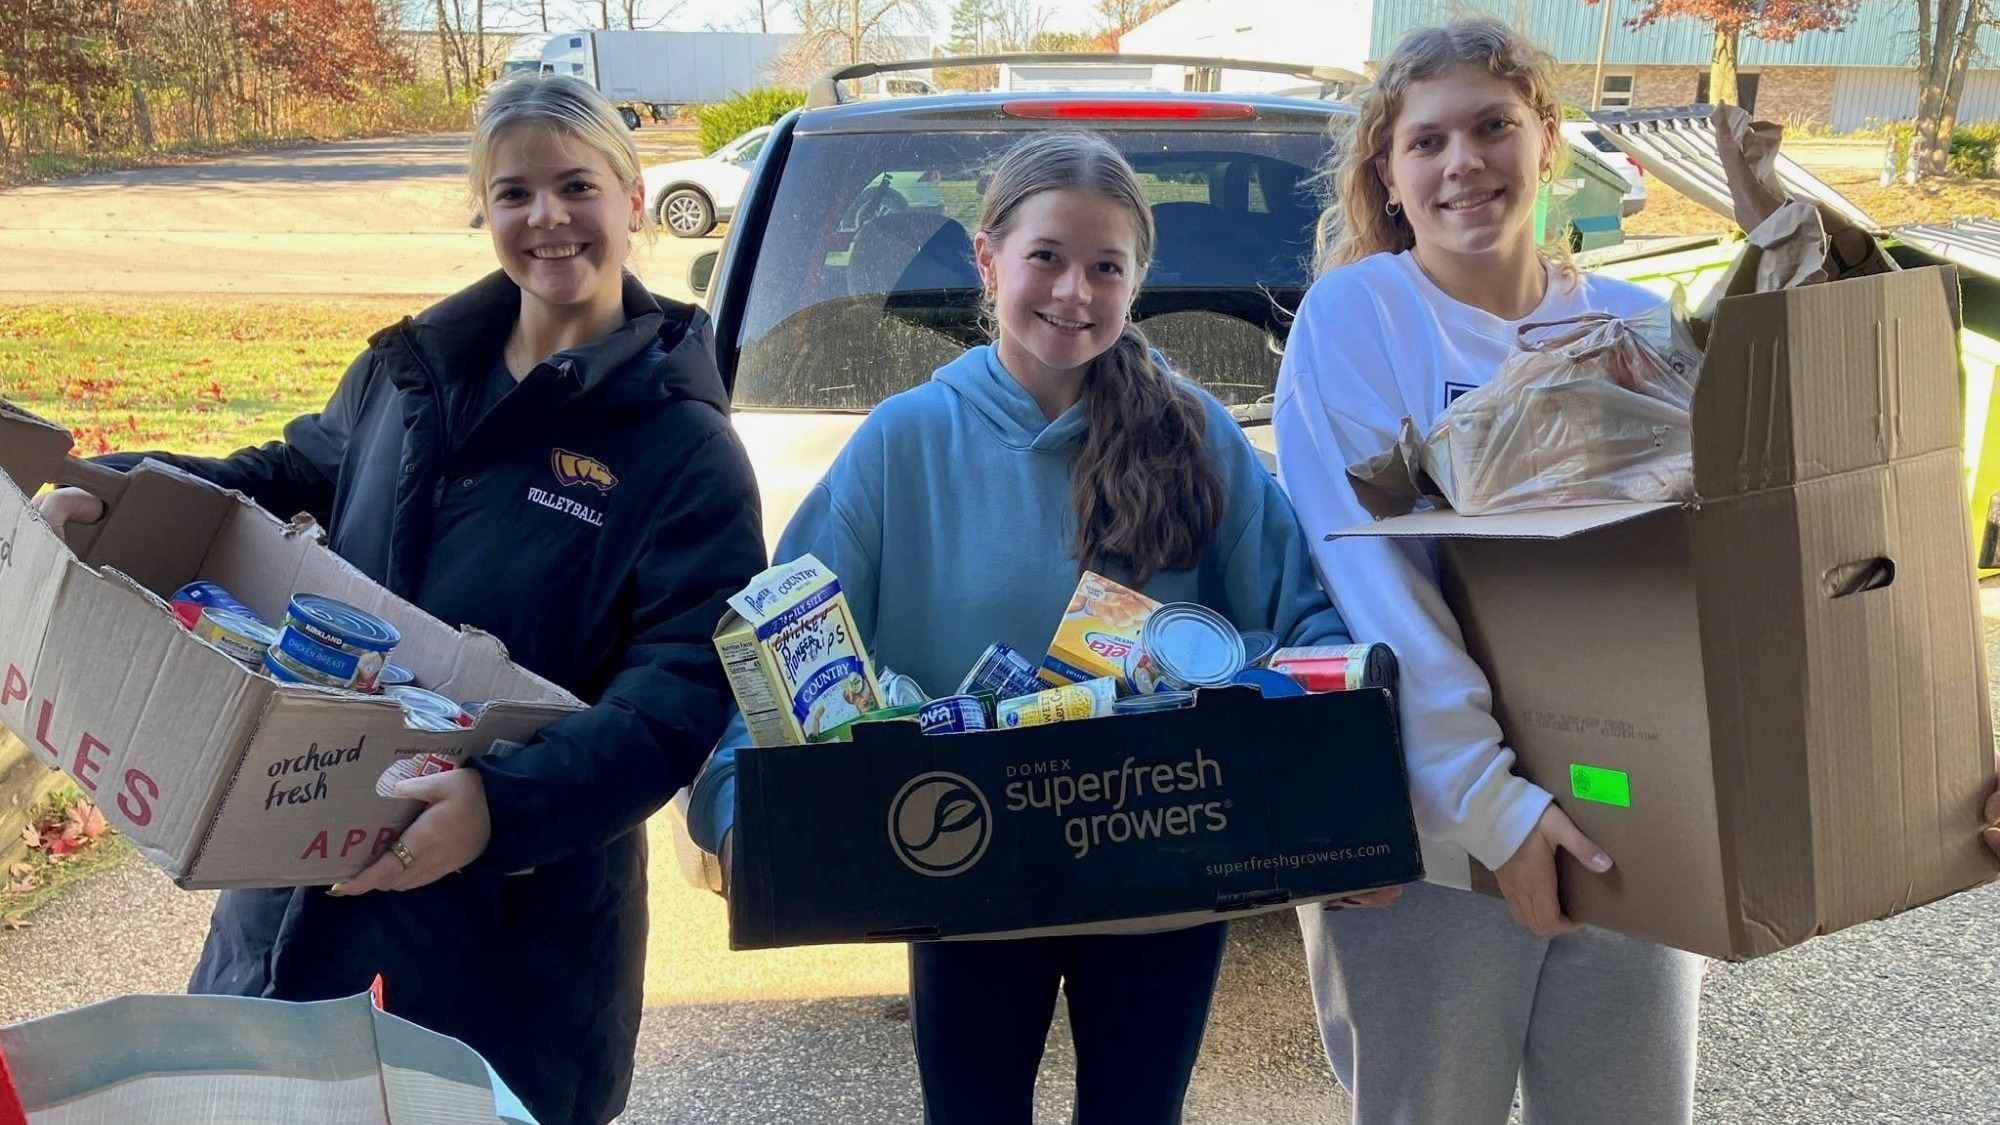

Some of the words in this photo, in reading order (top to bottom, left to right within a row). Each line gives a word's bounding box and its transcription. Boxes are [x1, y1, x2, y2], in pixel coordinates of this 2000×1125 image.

[527, 486, 603, 526] VOLLEYBALL
[778, 568, 818, 595] COUNTRY
[305, 623, 343, 646] KIRKLAND
[317, 650, 346, 669] BREAST
[802, 662, 850, 704] COUNTRY
[920, 705, 951, 727] OYA
[1041, 696, 1052, 723] WEET
[1, 663, 159, 827] PLES
[267, 734, 366, 778] orchard
[1005, 748, 1223, 817] superfresh
[1006, 758, 1072, 777] DOMEX
[265, 772, 328, 811] fresh
[300, 826, 400, 860] APP
[1206, 843, 1391, 877] superfreshgrowers.com
